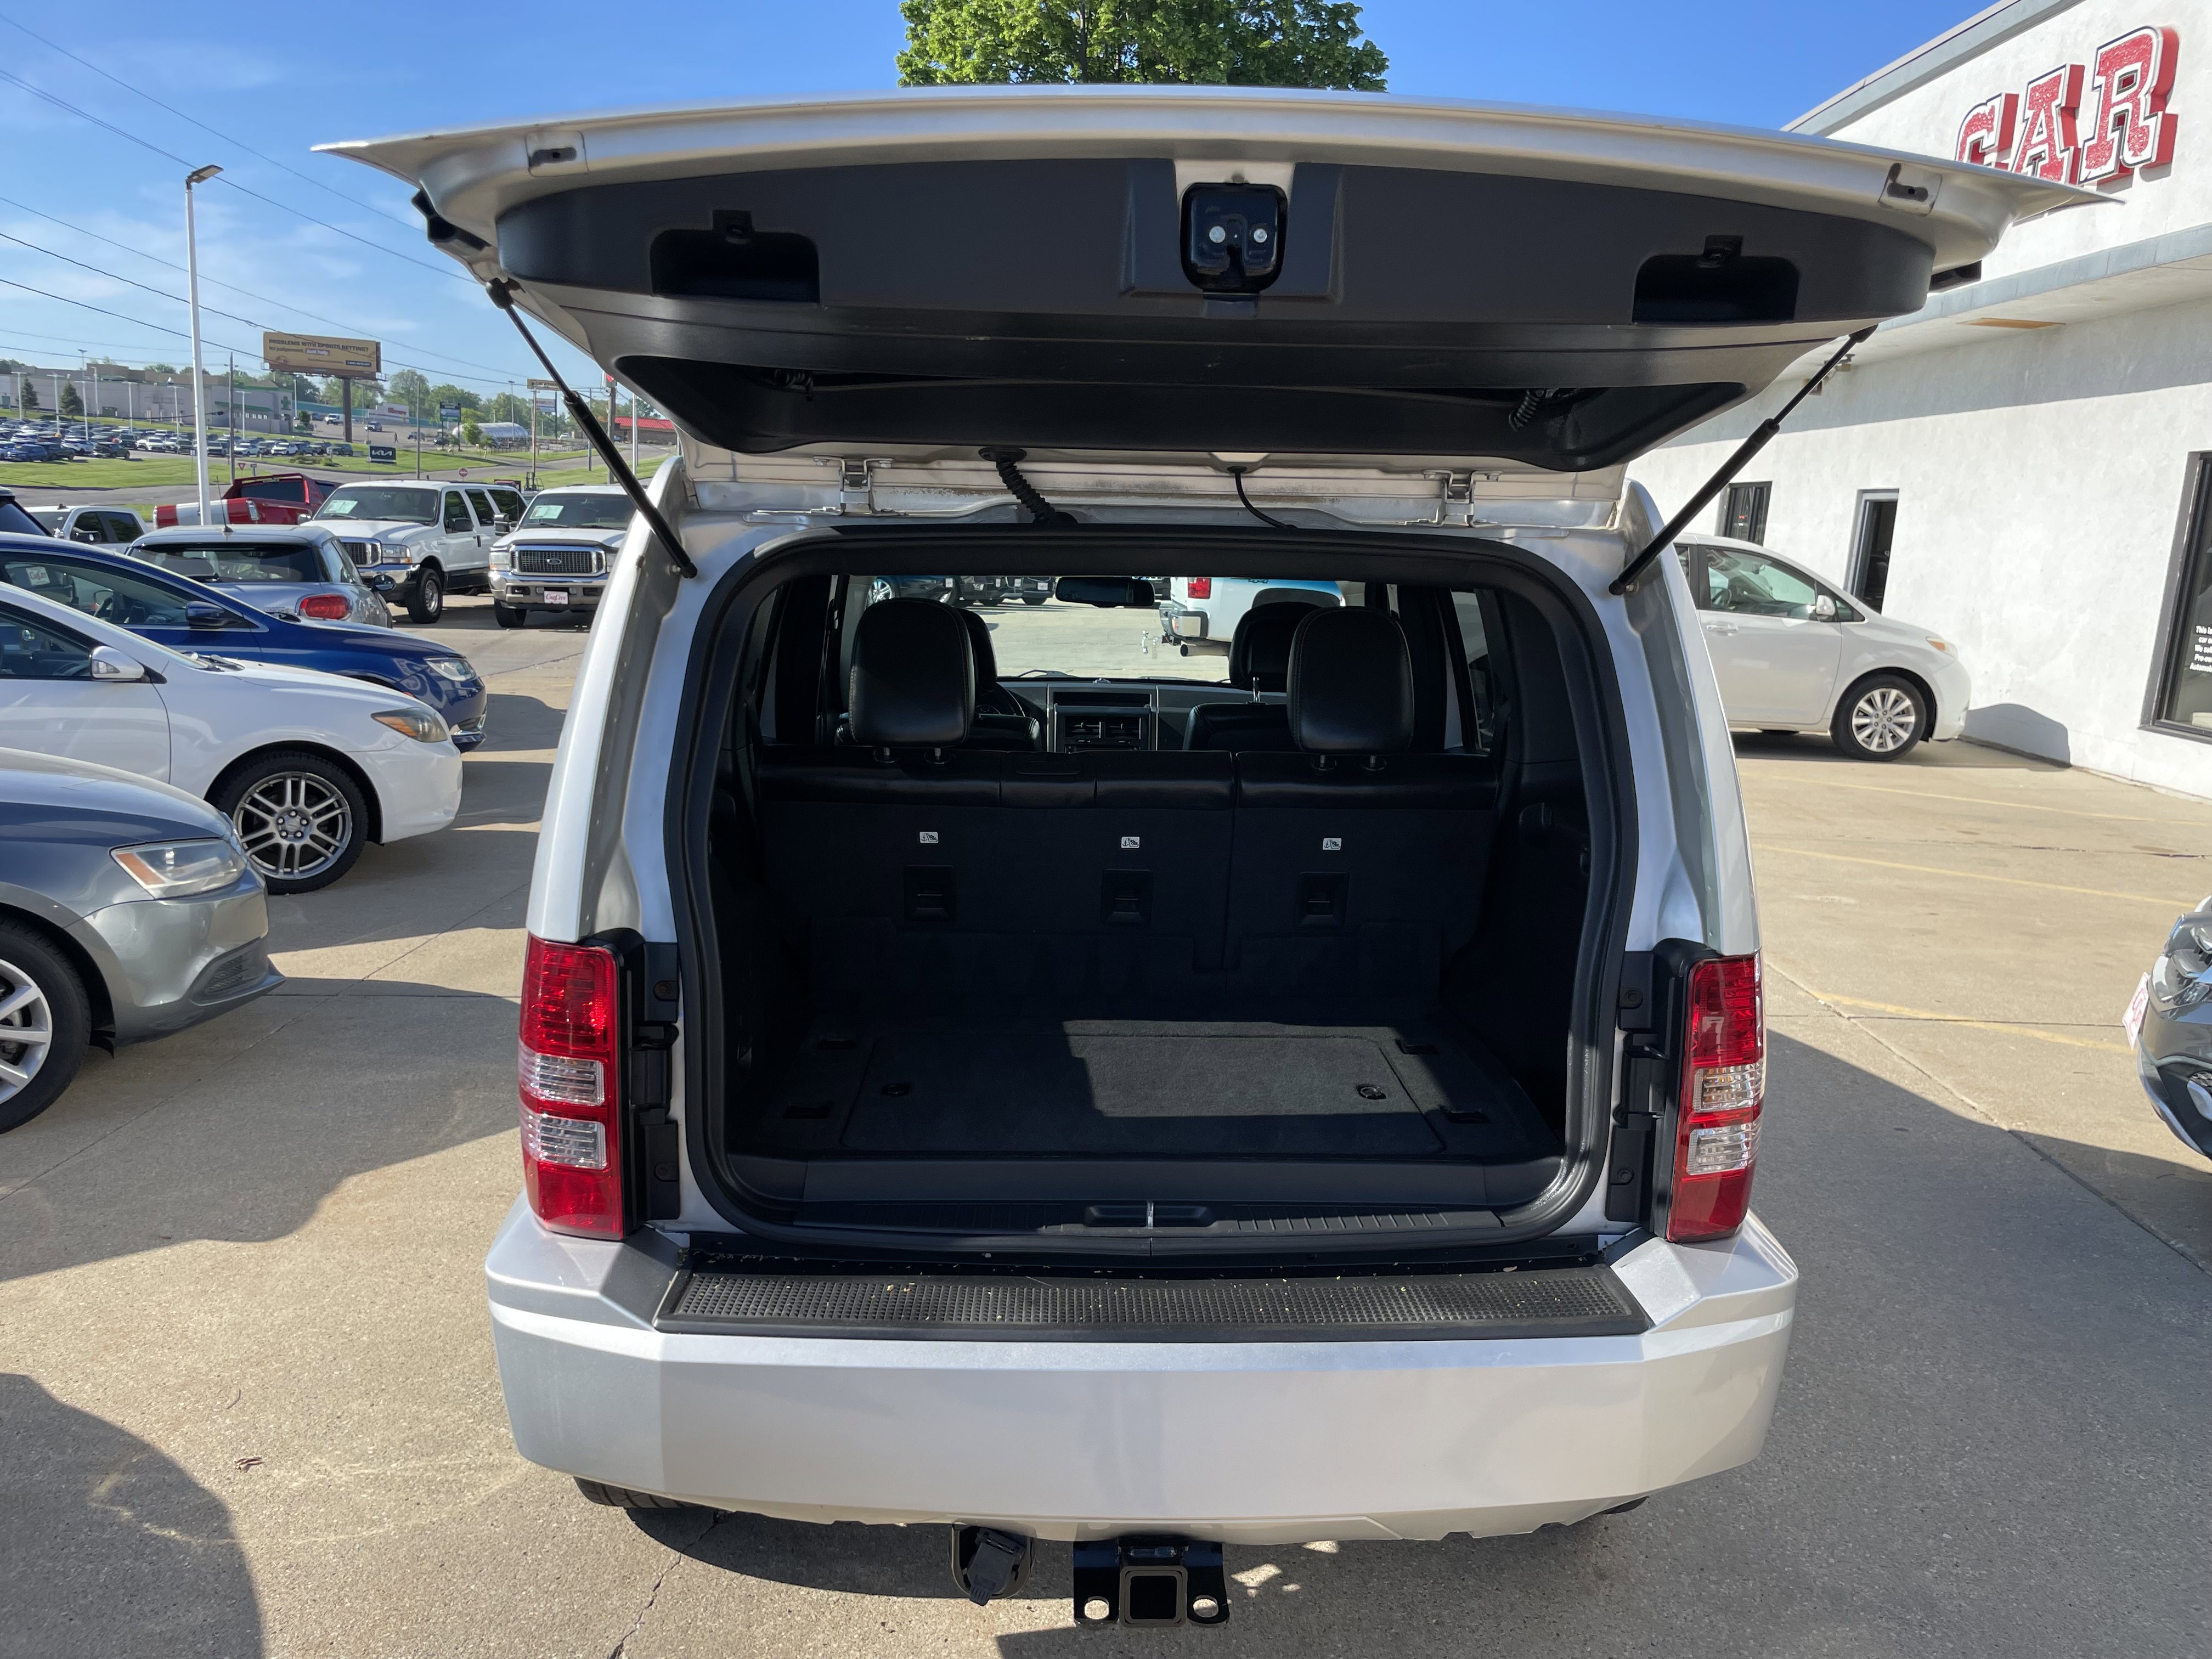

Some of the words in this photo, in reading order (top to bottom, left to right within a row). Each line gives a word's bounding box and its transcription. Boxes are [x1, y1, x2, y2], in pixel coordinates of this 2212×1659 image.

[1955, 26, 2179, 185] CAR
[2196, 625, 2207, 634] This
[2194, 644, 2203, 652] We
